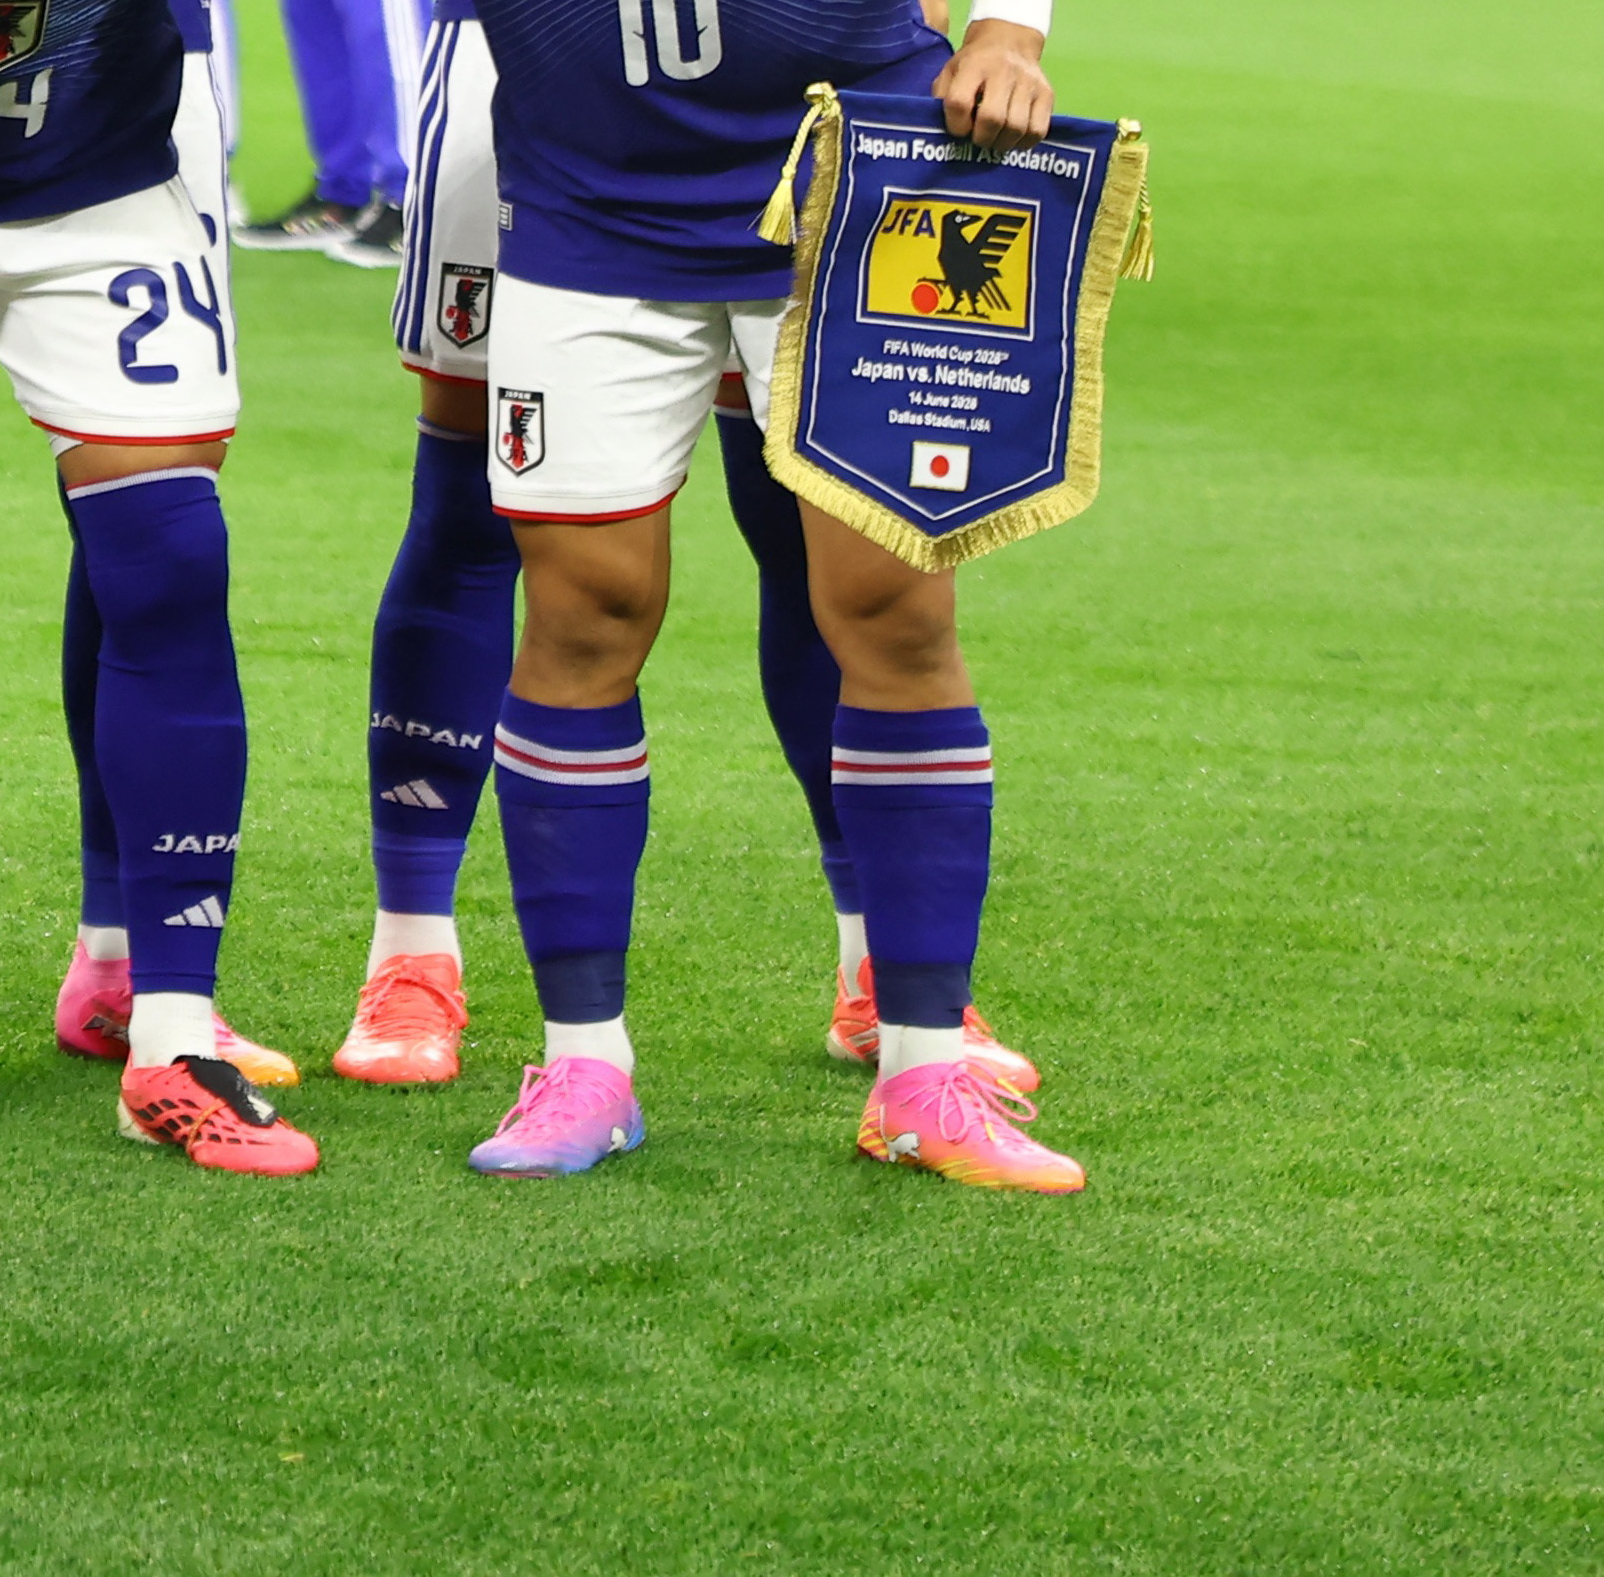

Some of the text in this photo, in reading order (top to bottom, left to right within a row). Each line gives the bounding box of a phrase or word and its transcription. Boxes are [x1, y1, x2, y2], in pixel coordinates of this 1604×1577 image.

[856, 134, 1080, 180] Japan Football Association
[882, 208, 936, 239] JFA
[107, 254, 228, 385] 24
[882, 340, 910, 357] FIFA
[910, 343, 947, 361] World
[948, 346, 973, 365] Cup
[852, 357, 1031, 395] Japan vs. Netherlands
[504, 390, 531, 400] JAPAN
[908, 391, 979, 411] 14 June 2026
[888, 409, 923, 426] Dallas
[970, 418, 991, 433] USA
[151, 833, 240, 855] JAPA
